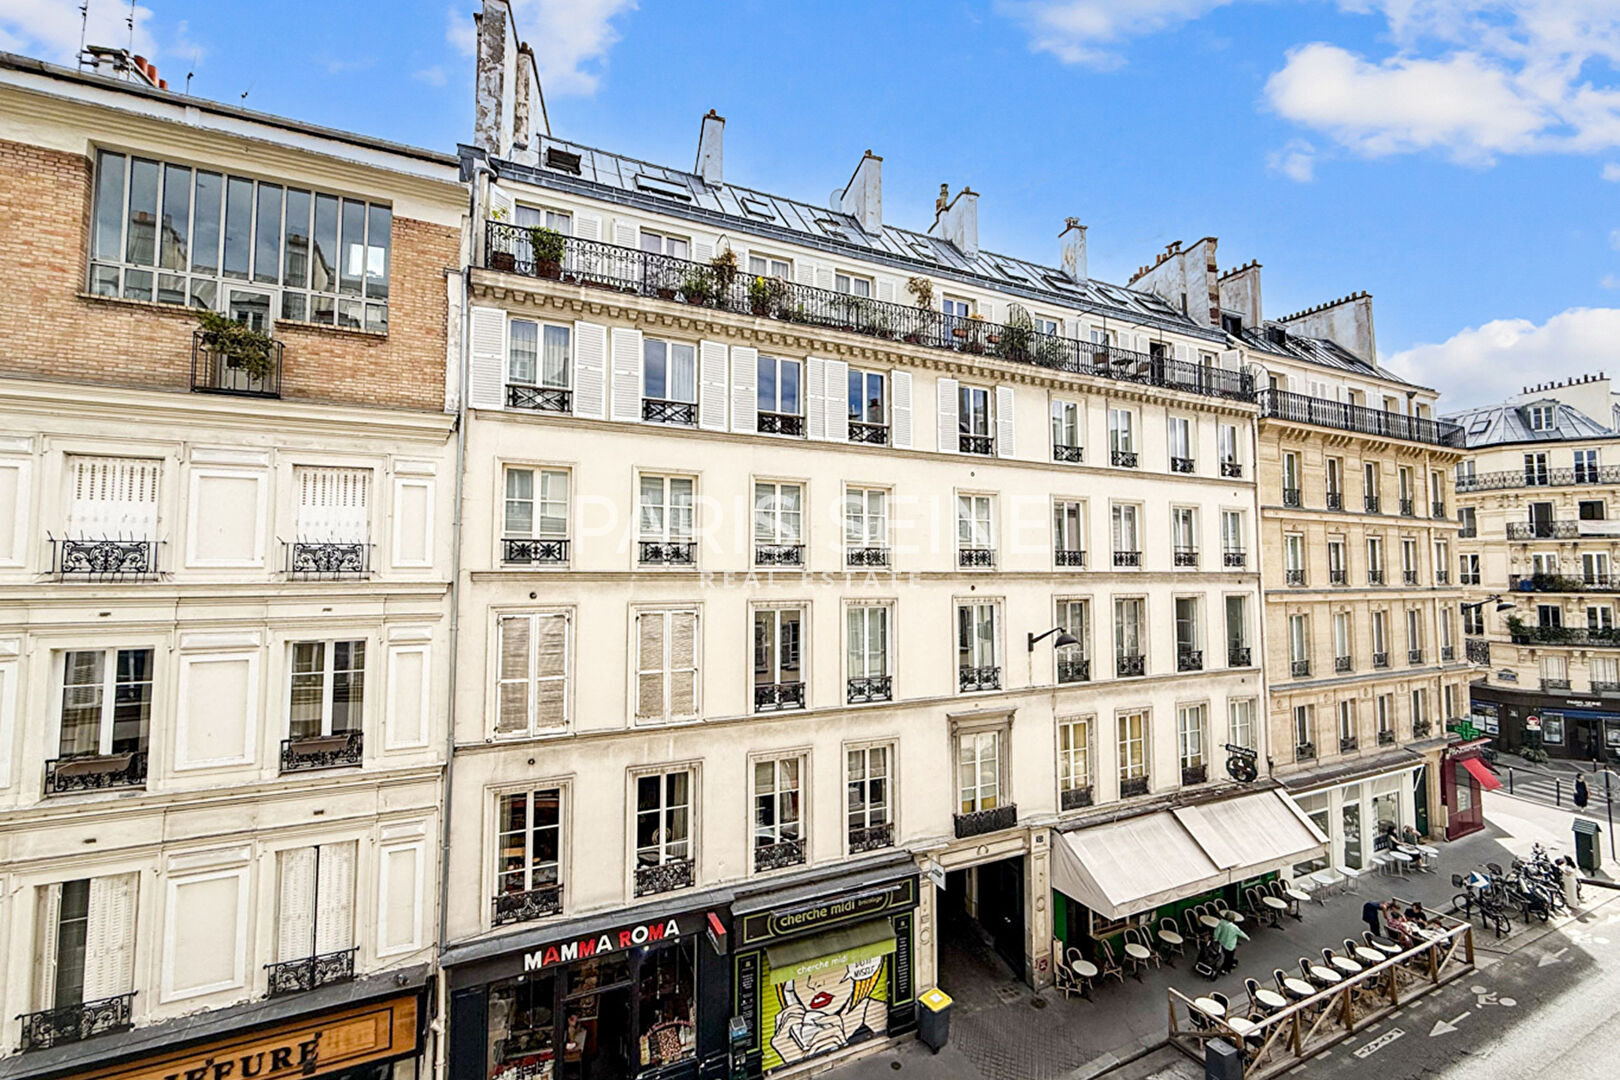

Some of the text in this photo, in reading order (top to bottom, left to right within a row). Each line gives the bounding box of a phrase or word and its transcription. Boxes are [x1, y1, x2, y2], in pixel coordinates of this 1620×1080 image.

[780, 904, 828, 927] cherche
[830, 899, 855, 916] midi
[524, 934, 613, 971] MAMMA
[618, 919, 681, 948] ROMA
